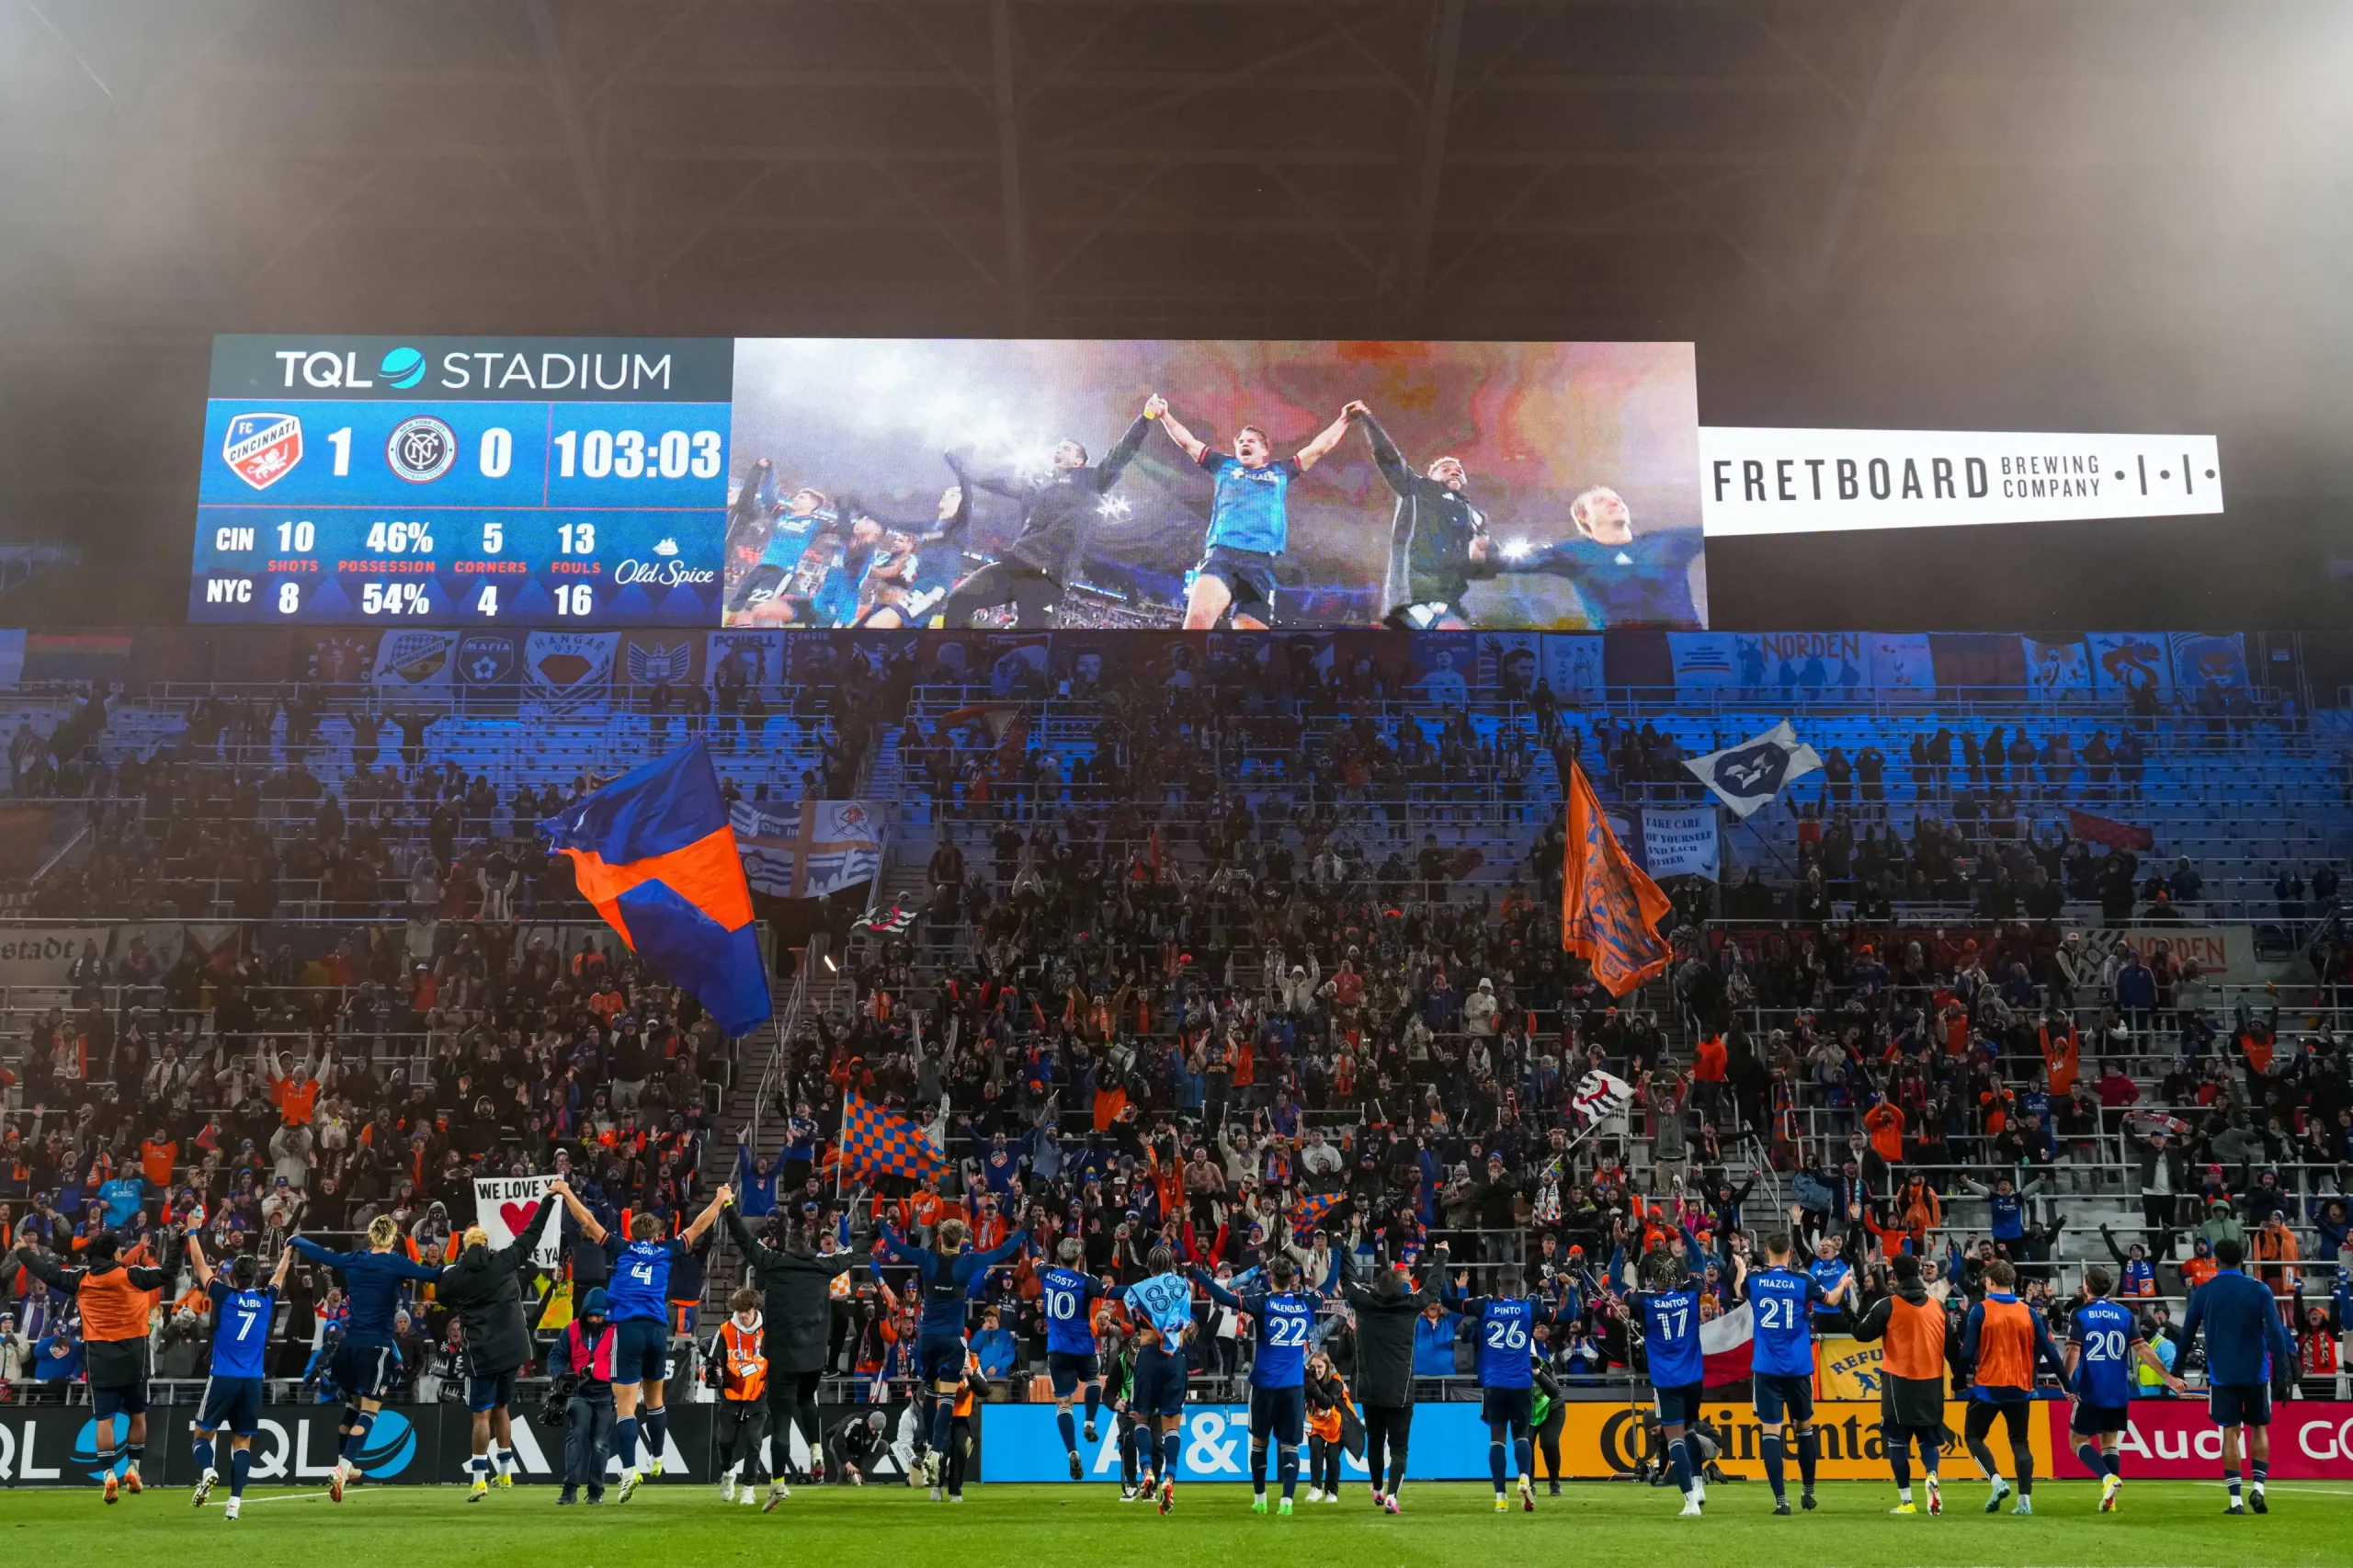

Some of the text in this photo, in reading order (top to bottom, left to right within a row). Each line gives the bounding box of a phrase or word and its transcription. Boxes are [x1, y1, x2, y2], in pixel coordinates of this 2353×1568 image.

[276, 350, 671, 391] TQL STADIUM
[230, 421, 297, 461] CINCINNATI
[238, 421, 254, 436] FC
[327, 426, 352, 476] 1
[479, 426, 513, 478] 0
[553, 428, 722, 479] 103:03
[2001, 454, 2100, 475] BREWING
[1712, 456, 1989, 502] FRETBOARD
[2002, 477, 2101, 499] COMPANY
[215, 520, 596, 555] CIN 10 46% 5 13
[267, 560, 602, 575] SHOTS POSSESSION CORNERS FOULS
[615, 558, 715, 588] Old Spice
[206, 578, 593, 618] NYC 8 54% 4 16
[464, 642, 511, 652] MAFIA
[536, 634, 606, 652] HANGAR
[554, 644, 581, 654] 937
[714, 632, 777, 648] POWELL
[1761, 632, 1860, 663] NORDEN
[1645, 830, 1713, 844] OF YOURSELF
[1646, 817, 1701, 829] TAKE CARE
[1647, 845, 1698, 856] AND EACH
[1648, 855, 1685, 869] OTHER
[477, 1182, 501, 1199] WE
[504, 1180, 540, 1199] LOVE
[631, 1260, 653, 1286] 4
[1758, 1278, 1796, 1290] MIAZGA
[1045, 1287, 1076, 1320] 10
[1144, 1275, 1188, 1314] 88
[1654, 1296, 1689, 1309] SANTOS
[1494, 1306, 1521, 1315] PINTO
[1656, 1308, 1688, 1341] 17
[1759, 1297, 1793, 1329] 21
[2087, 1310, 2120, 1320] BUCHA
[236, 1311, 256, 1341] 7
[1269, 1316, 1307, 1346] 22
[1486, 1320, 1527, 1349] 26
[2086, 1330, 2126, 1361] 20
[1830, 1347, 1883, 1375] REFU
[1093, 1412, 1252, 1473] A&
[1600, 1408, 1915, 1472] Cotinenta
[2116, 1419, 2247, 1460] Audi
